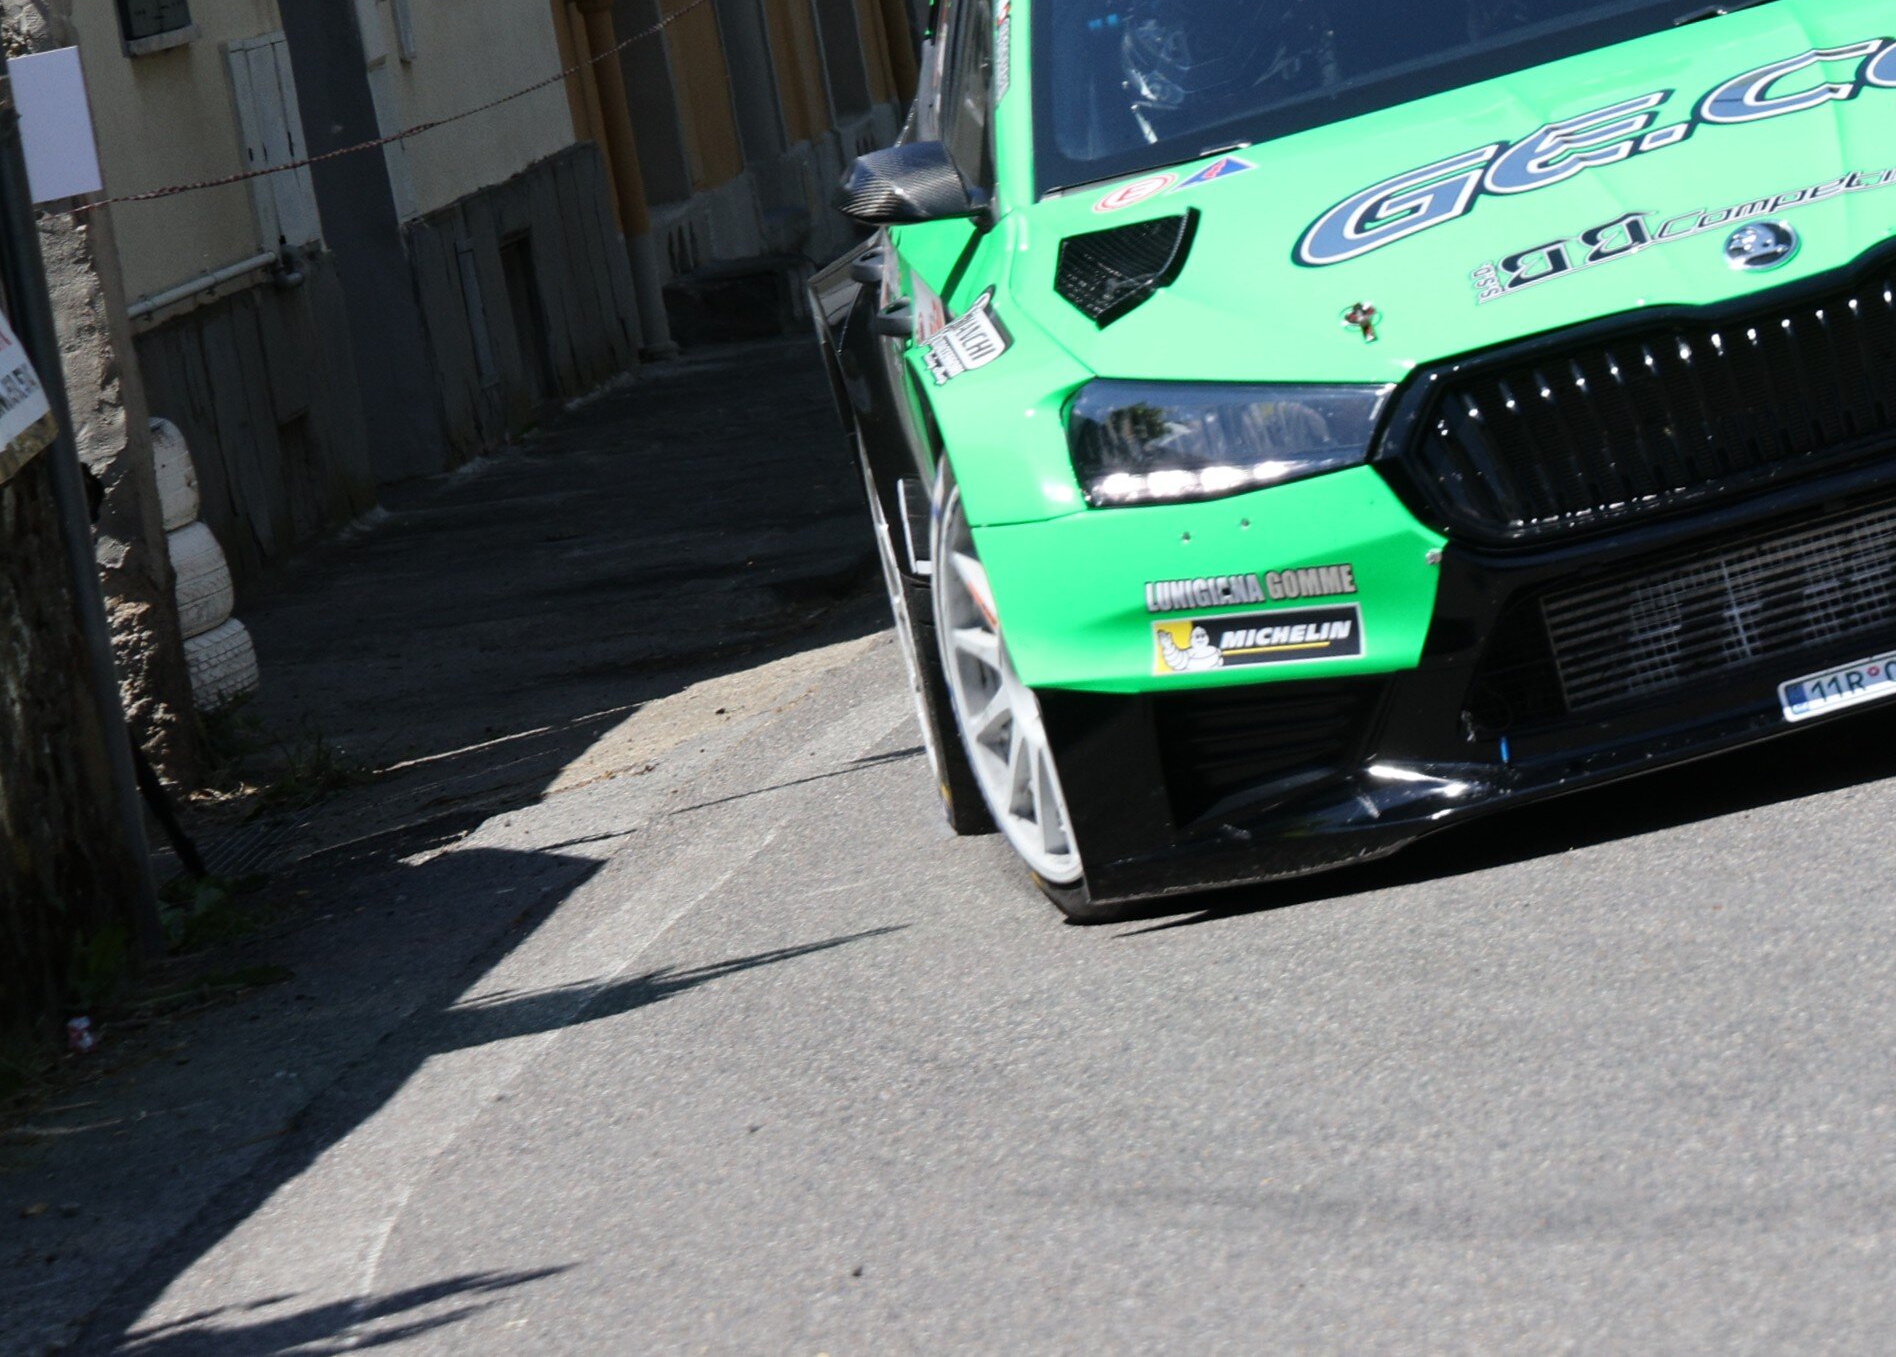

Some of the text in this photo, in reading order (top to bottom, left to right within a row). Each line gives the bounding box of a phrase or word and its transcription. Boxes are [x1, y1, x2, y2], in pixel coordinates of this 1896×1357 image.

[1144, 562, 1358, 614] LUNIGIANA GOMME
[1219, 619, 1353, 651] MICHELIN
[1810, 670, 1868, 703] 11R
